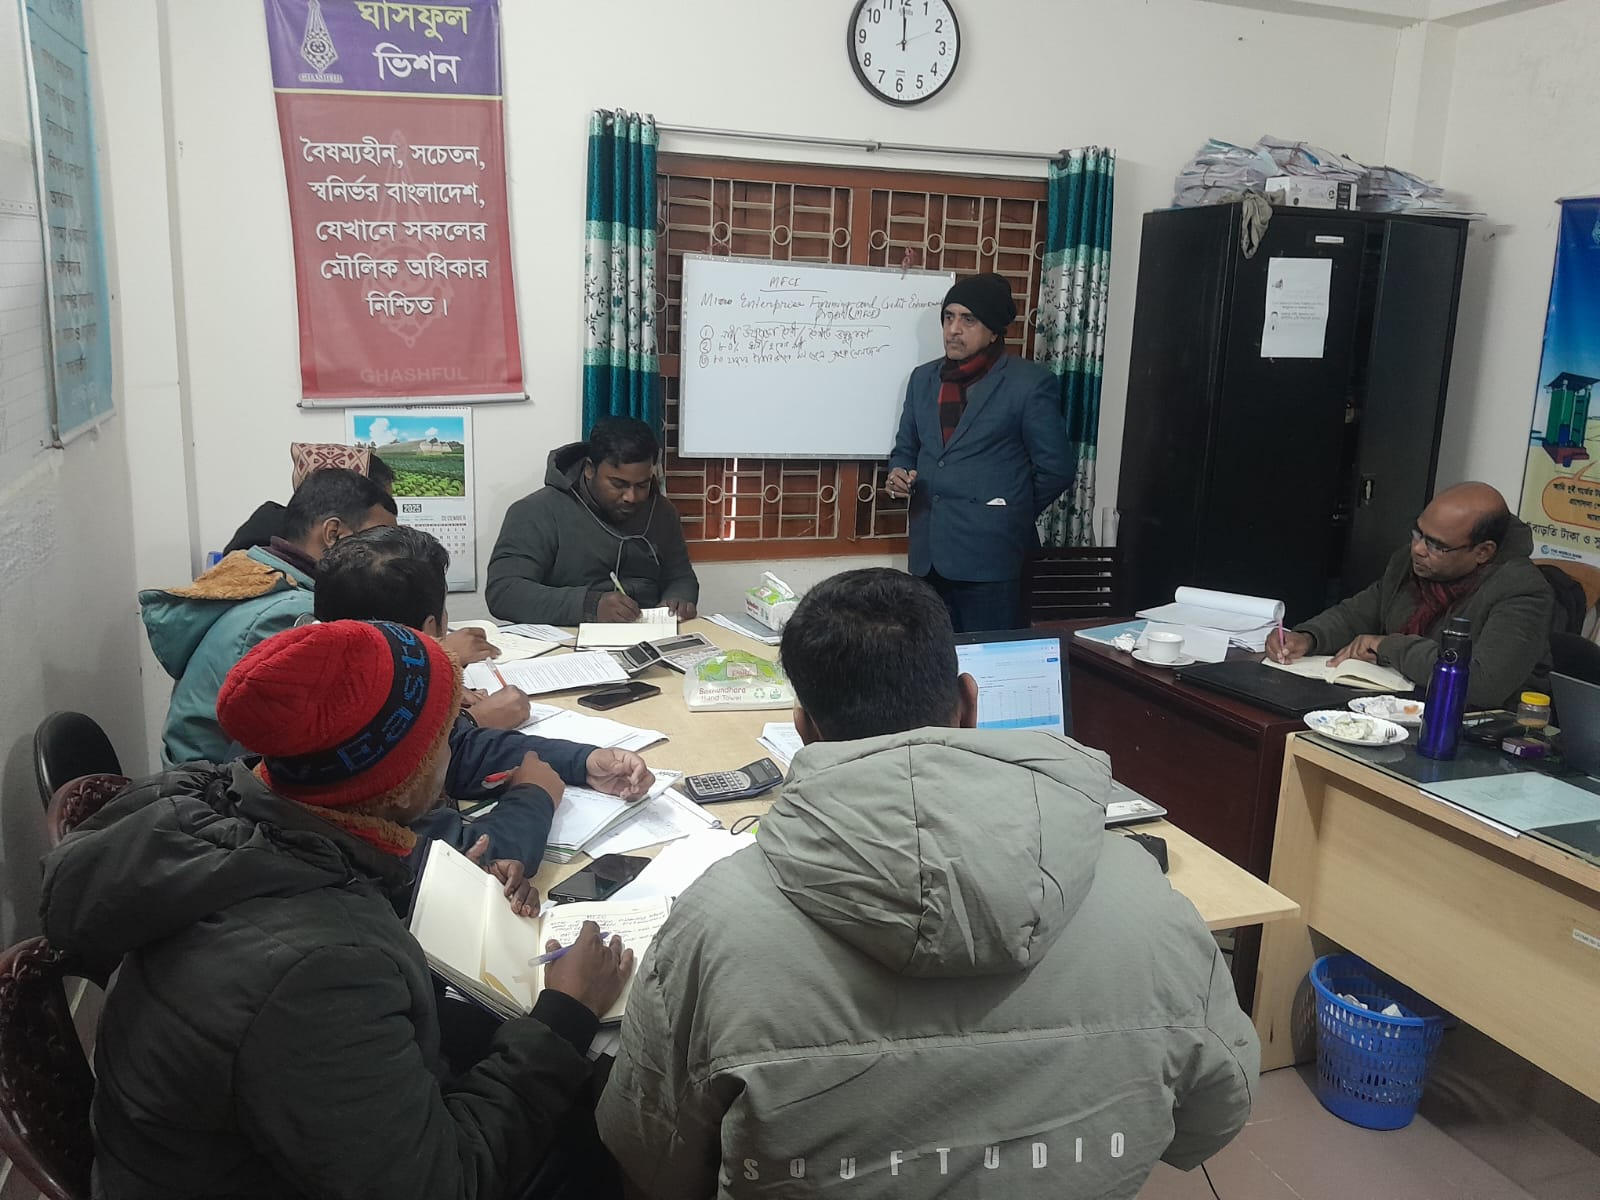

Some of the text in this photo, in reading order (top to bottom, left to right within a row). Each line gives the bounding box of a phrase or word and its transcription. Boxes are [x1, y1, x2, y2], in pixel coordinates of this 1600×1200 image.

[866, 8, 881, 24] 10
[923, 1, 929, 16] 1
[356, 0, 472, 42] ঘাসফুল
[935, 19, 943, 34] 2
[859, 28, 867, 44] 9
[939, 41, 946, 56] 3
[372, 42, 461, 83] ভিশন
[864, 52, 872, 67] 8
[878, 69, 886, 84] 7
[930, 61, 938, 77] 4
[896, 77, 904, 93] 6
[916, 74, 924, 89] 5
[300, 136, 485, 170] বৈষম্যহীন, সচেতন,
[308, 175, 485, 208] স্বনির্ভর বাংলাদেশ,
[316, 218, 488, 242] যেখানে সকলের
[320, 252, 489, 280] মৌলিক অধিকার
[366, 290, 435, 317] নিশ্চিত
[360, 367, 469, 384] GHASHFUL
[404, 504, 421, 512] 2025
[1560, 527, 1580, 544] টাকা
